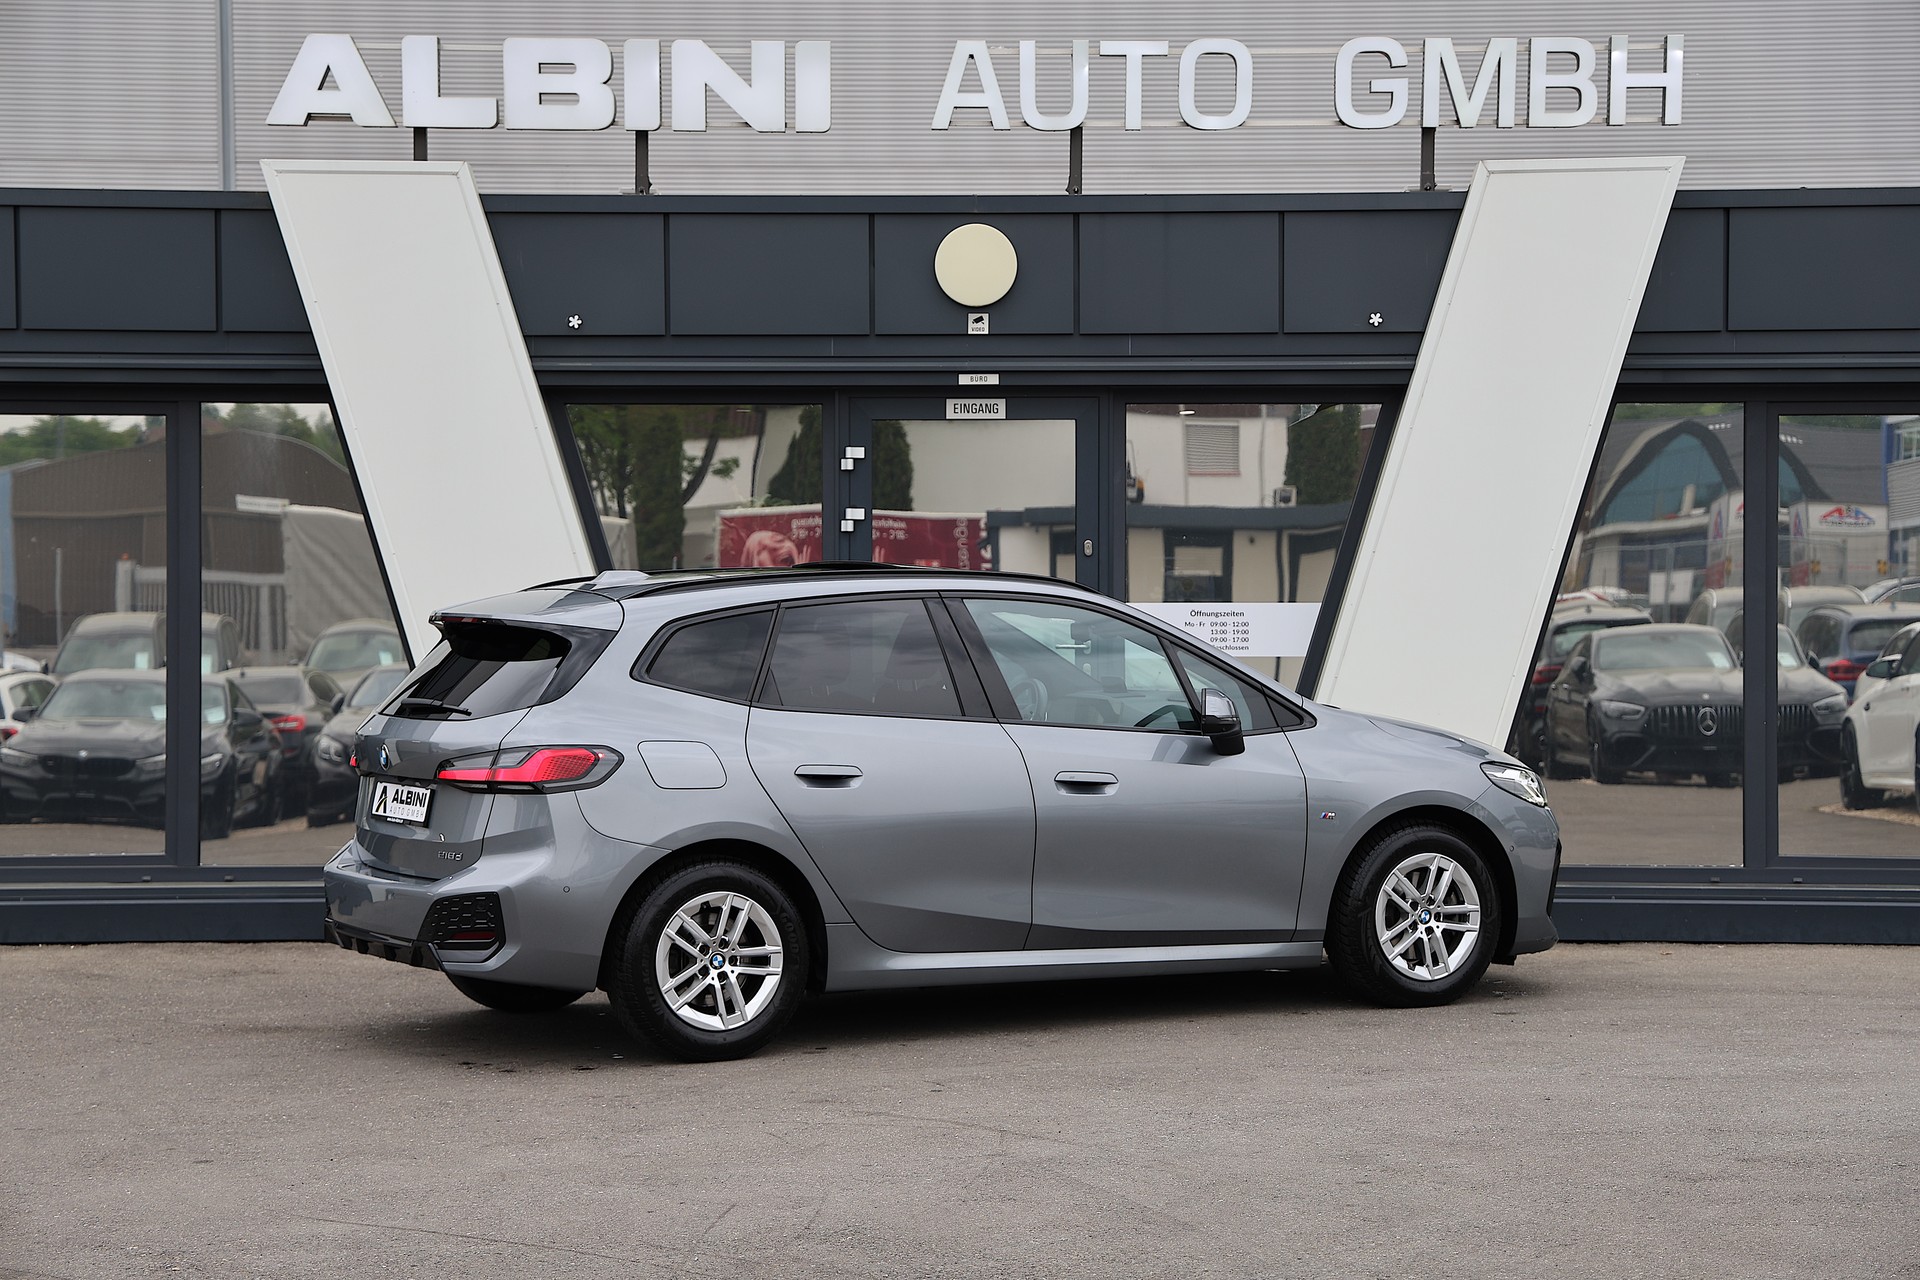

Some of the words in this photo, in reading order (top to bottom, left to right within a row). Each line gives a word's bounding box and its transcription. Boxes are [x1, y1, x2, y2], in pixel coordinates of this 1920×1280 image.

[265, 33, 832, 133] ALBINI
[931, 38, 1254, 132] AUTO
[1333, 33, 1685, 130] GMBH
[970, 375, 988, 383] BÜRO
[953, 402, 999, 414] EINGANG
[1189, 609, 1245, 618] Öffnungszeiten
[391, 788, 428, 808] ALBINI
[389, 806, 405, 816] AUTO
[406, 808, 424, 818] GMBH
